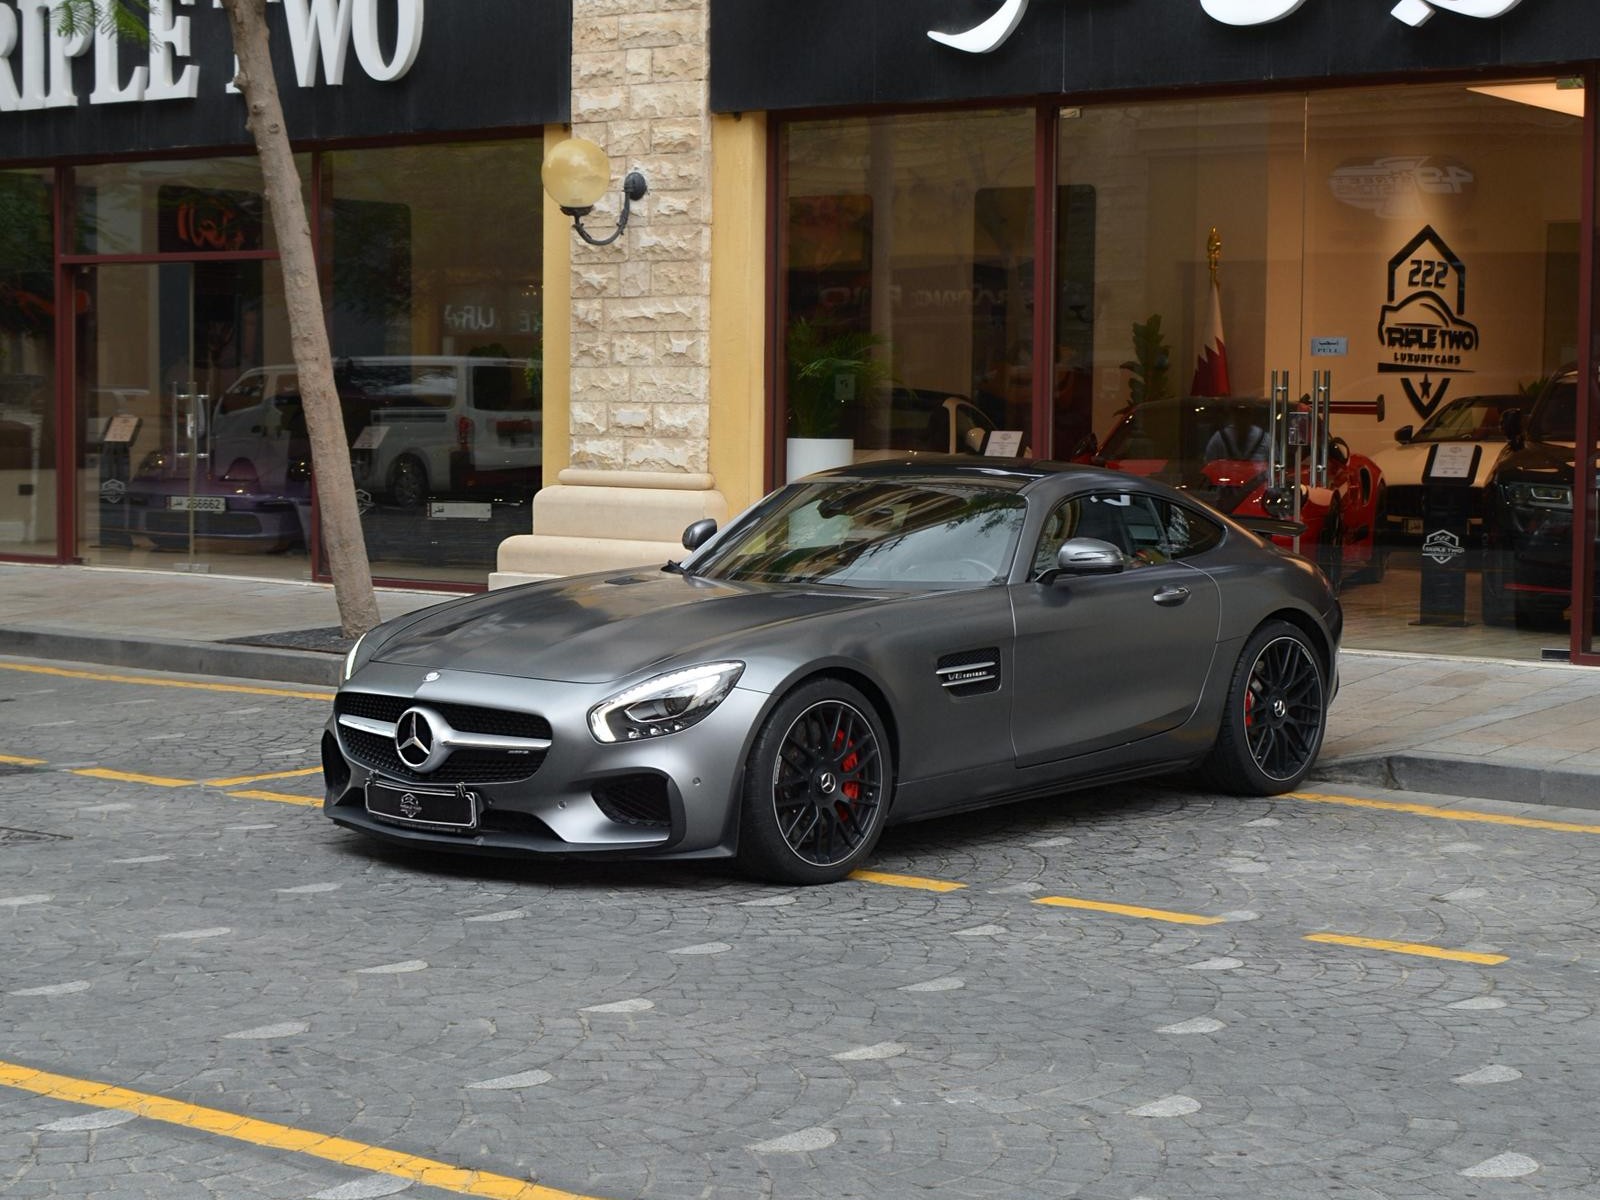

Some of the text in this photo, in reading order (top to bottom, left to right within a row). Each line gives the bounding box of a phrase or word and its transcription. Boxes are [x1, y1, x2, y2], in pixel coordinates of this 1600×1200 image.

[213, 0, 424, 94] WO
[1408, 260, 1448, 288] 222
[1439, 330, 1474, 350] TWO
[1394, 352, 1461, 365] LUXURY CARS
